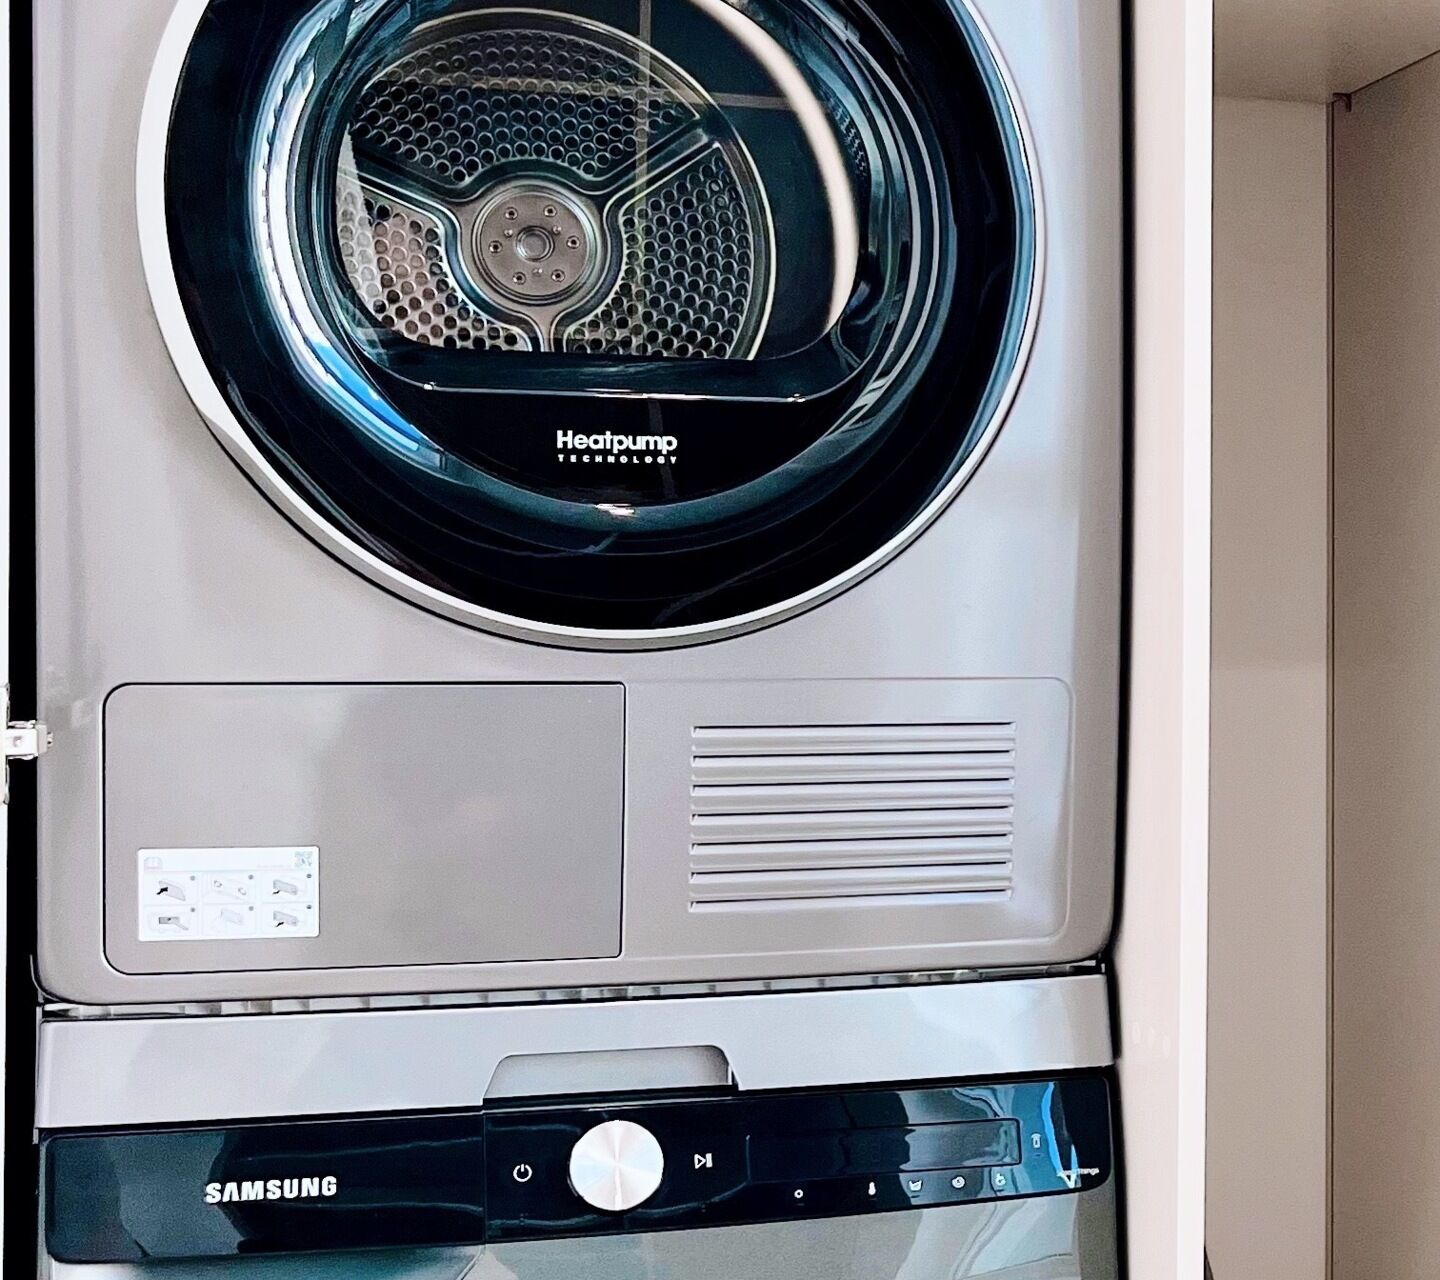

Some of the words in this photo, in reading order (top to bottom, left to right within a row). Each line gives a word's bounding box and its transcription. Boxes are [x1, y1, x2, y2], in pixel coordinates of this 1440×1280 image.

[556, 429, 678, 455] Heatpump
[557, 454, 676, 464] TECHNOLOGY
[204, 1175, 338, 1204] SAMSUNG
